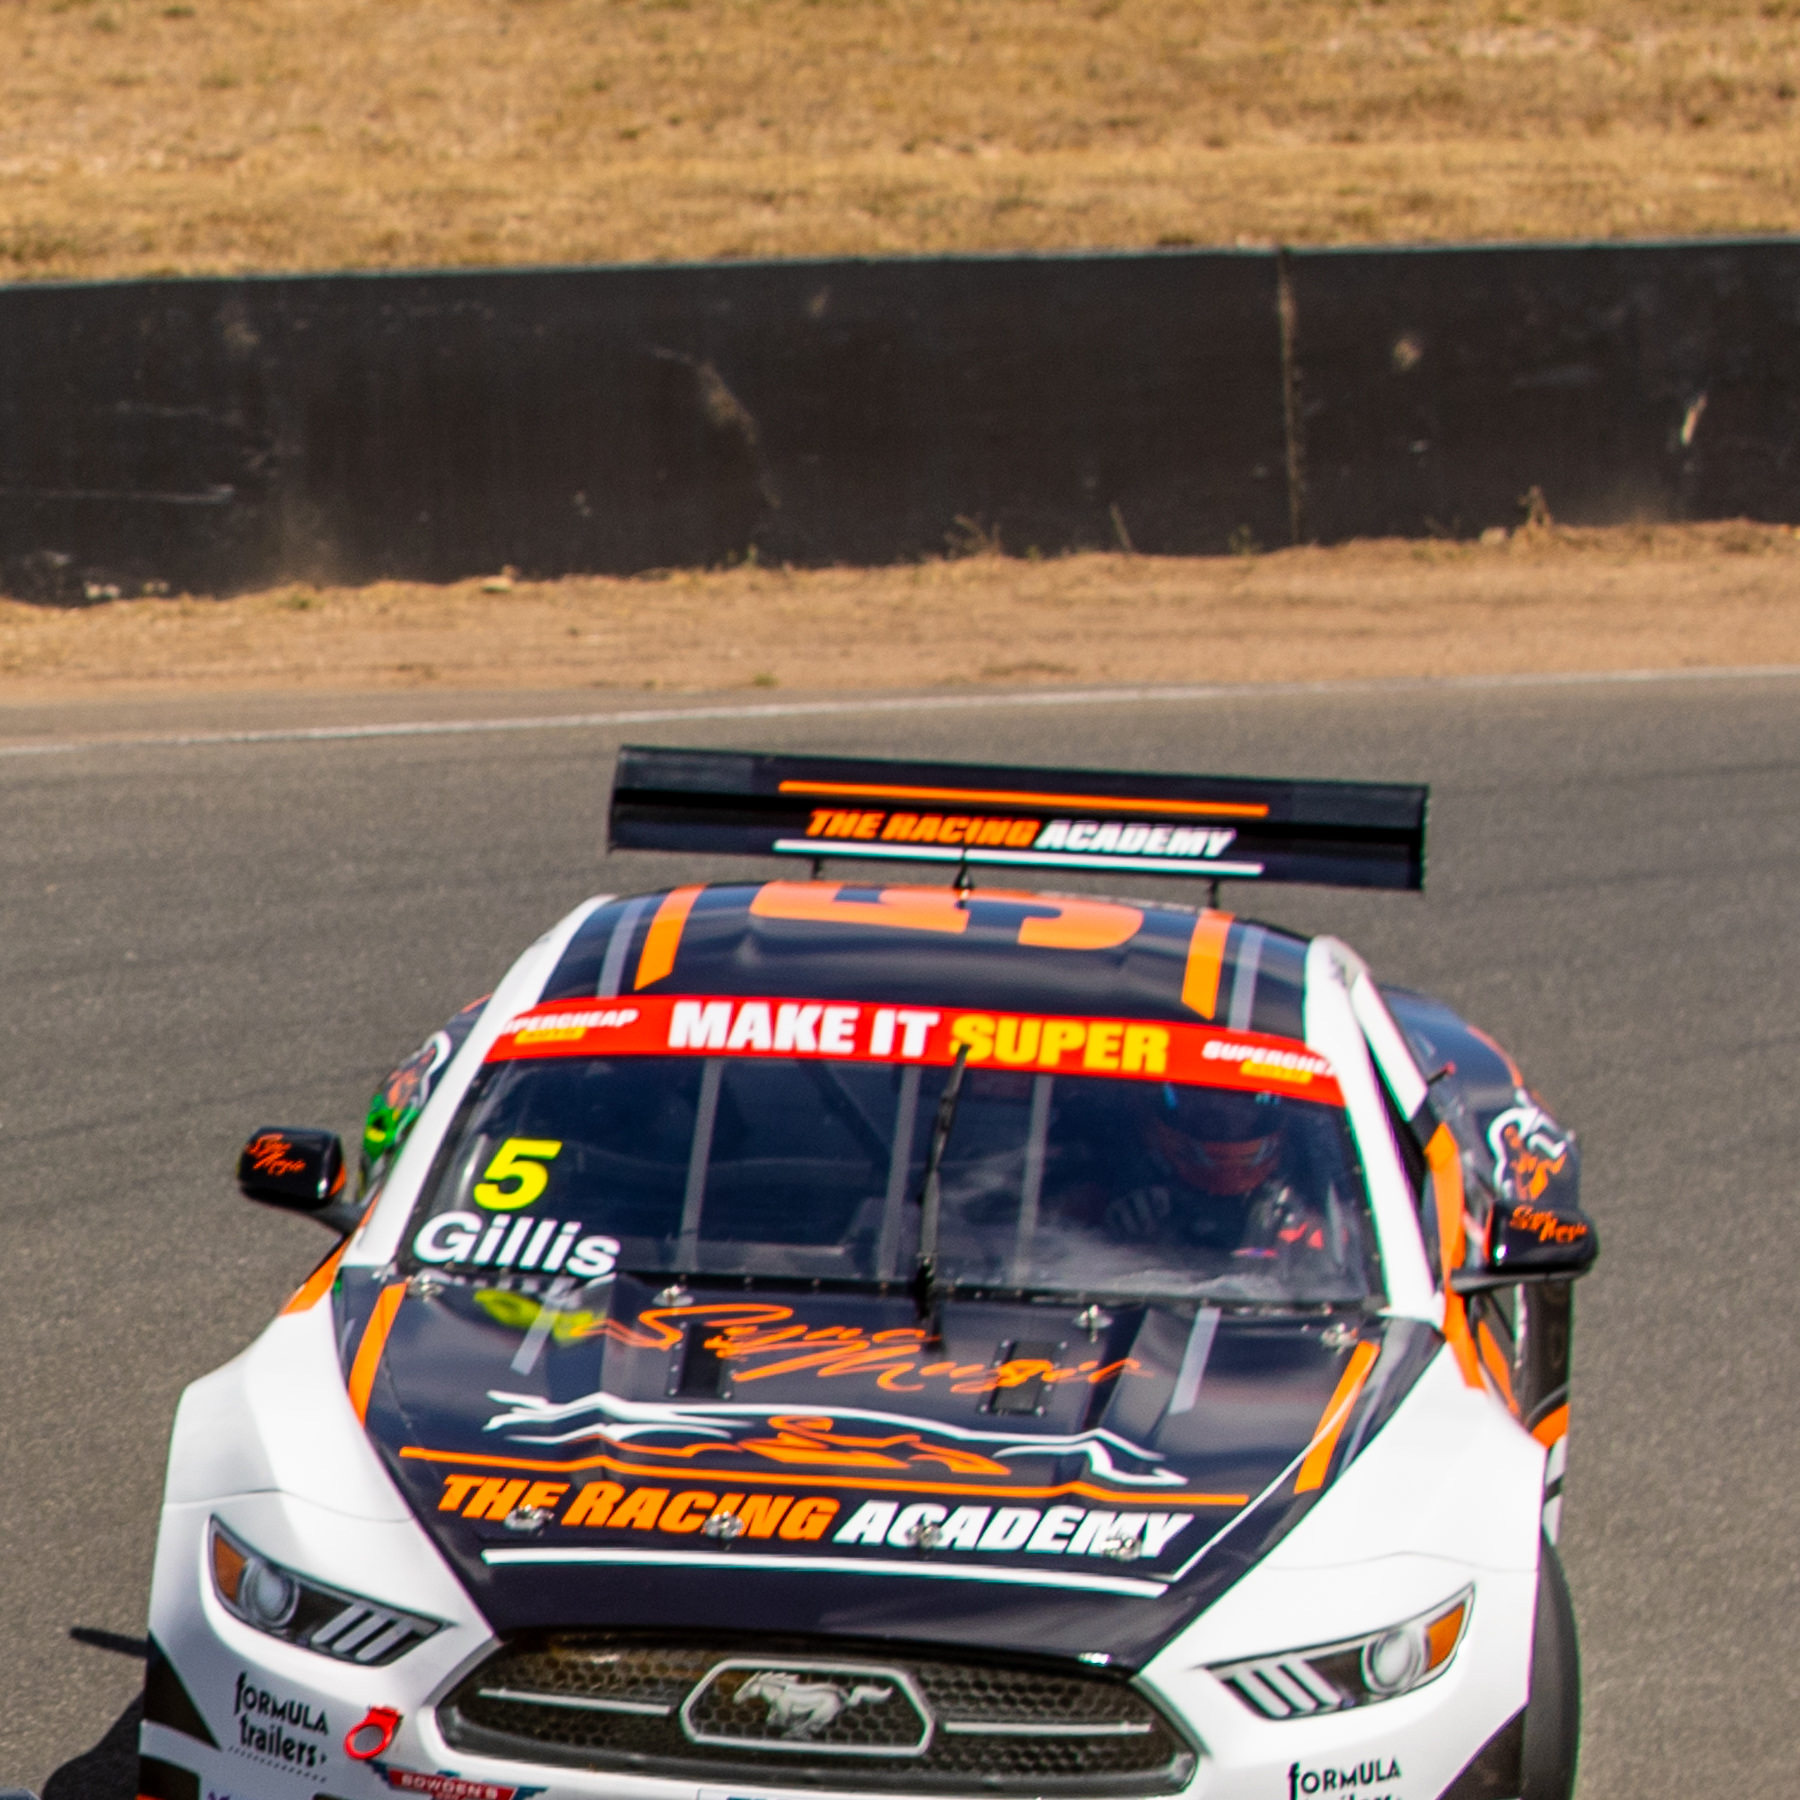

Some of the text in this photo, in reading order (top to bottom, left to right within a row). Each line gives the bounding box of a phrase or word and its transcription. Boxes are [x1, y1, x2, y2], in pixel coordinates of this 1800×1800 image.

[806, 809, 1237, 858] THE RACING ACADEMY
[668, 1000, 1169, 1074] MAKE IT SUPER
[474, 1137, 563, 1210] 5
[413, 1211, 620, 1278] Gillis
[437, 1473, 1195, 1559] THE RACING ACADEMY
